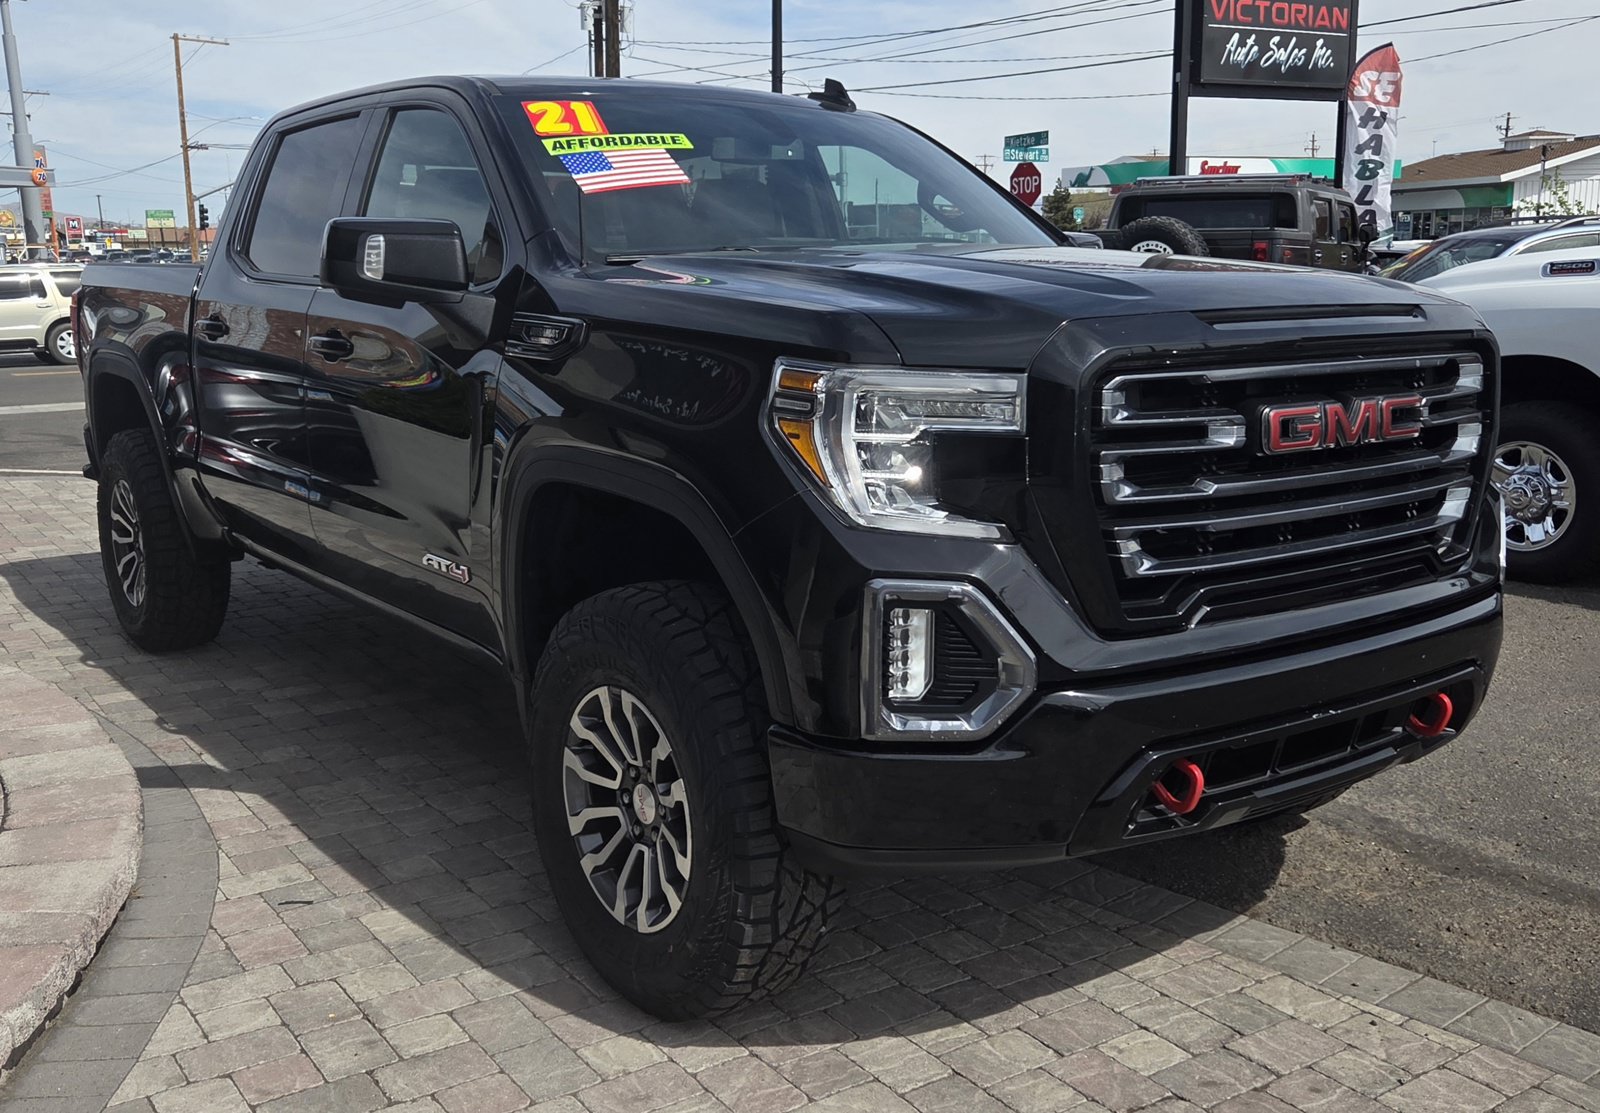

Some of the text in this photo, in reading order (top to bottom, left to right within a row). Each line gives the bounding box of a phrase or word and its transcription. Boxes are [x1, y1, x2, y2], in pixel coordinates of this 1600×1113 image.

[1209, 0, 1348, 30] VICTORIAN
[1221, 32, 1335, 74] Auto Sales Inc.
[1353, 70, 1400, 103] SE
[527, 101, 603, 134] 21
[552, 135, 682, 151] AFFORDABLE
[1010, 136, 1035, 147] Kietzke
[1010, 149, 1039, 160] Stewart
[37, 172, 47, 181] 76
[1354, 106, 1388, 226] HABLA
[1012, 176, 1039, 195] STOP
[1262, 395, 1422, 455] GMC
[422, 553, 470, 584] AT4
[637, 787, 648, 822] GMC
